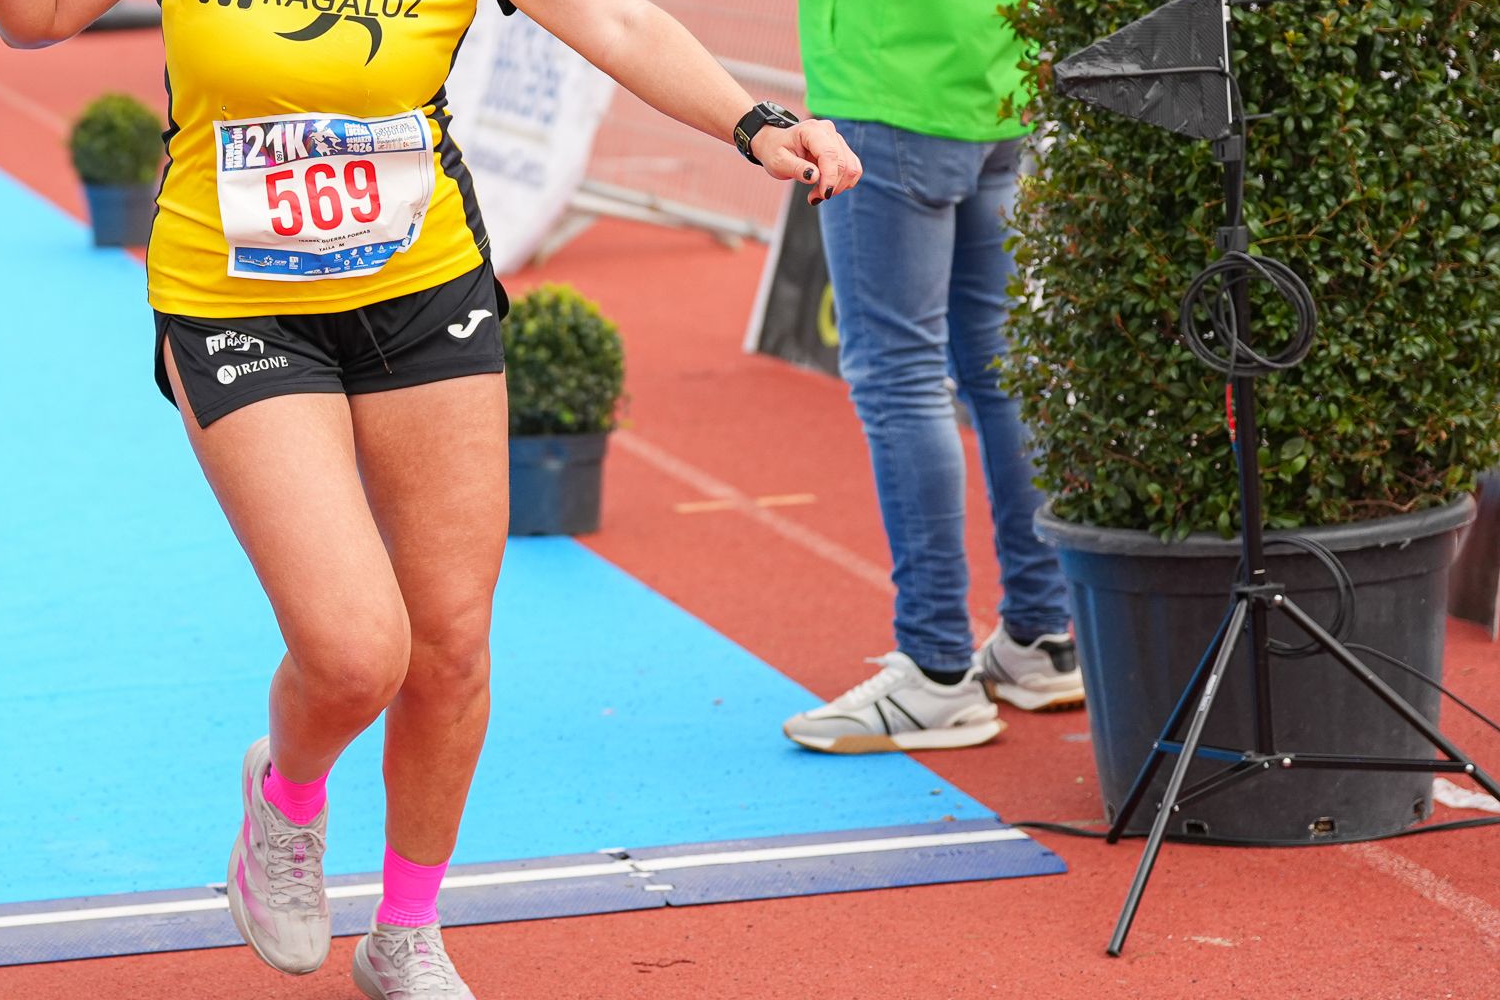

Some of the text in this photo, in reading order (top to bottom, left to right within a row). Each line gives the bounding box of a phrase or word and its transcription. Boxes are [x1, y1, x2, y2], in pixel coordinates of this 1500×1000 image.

[245, 121, 309, 167] 21K
[346, 143, 373, 153] 2026
[264, 159, 382, 237] 569
[217, 355, 289, 385] AIRZONE
